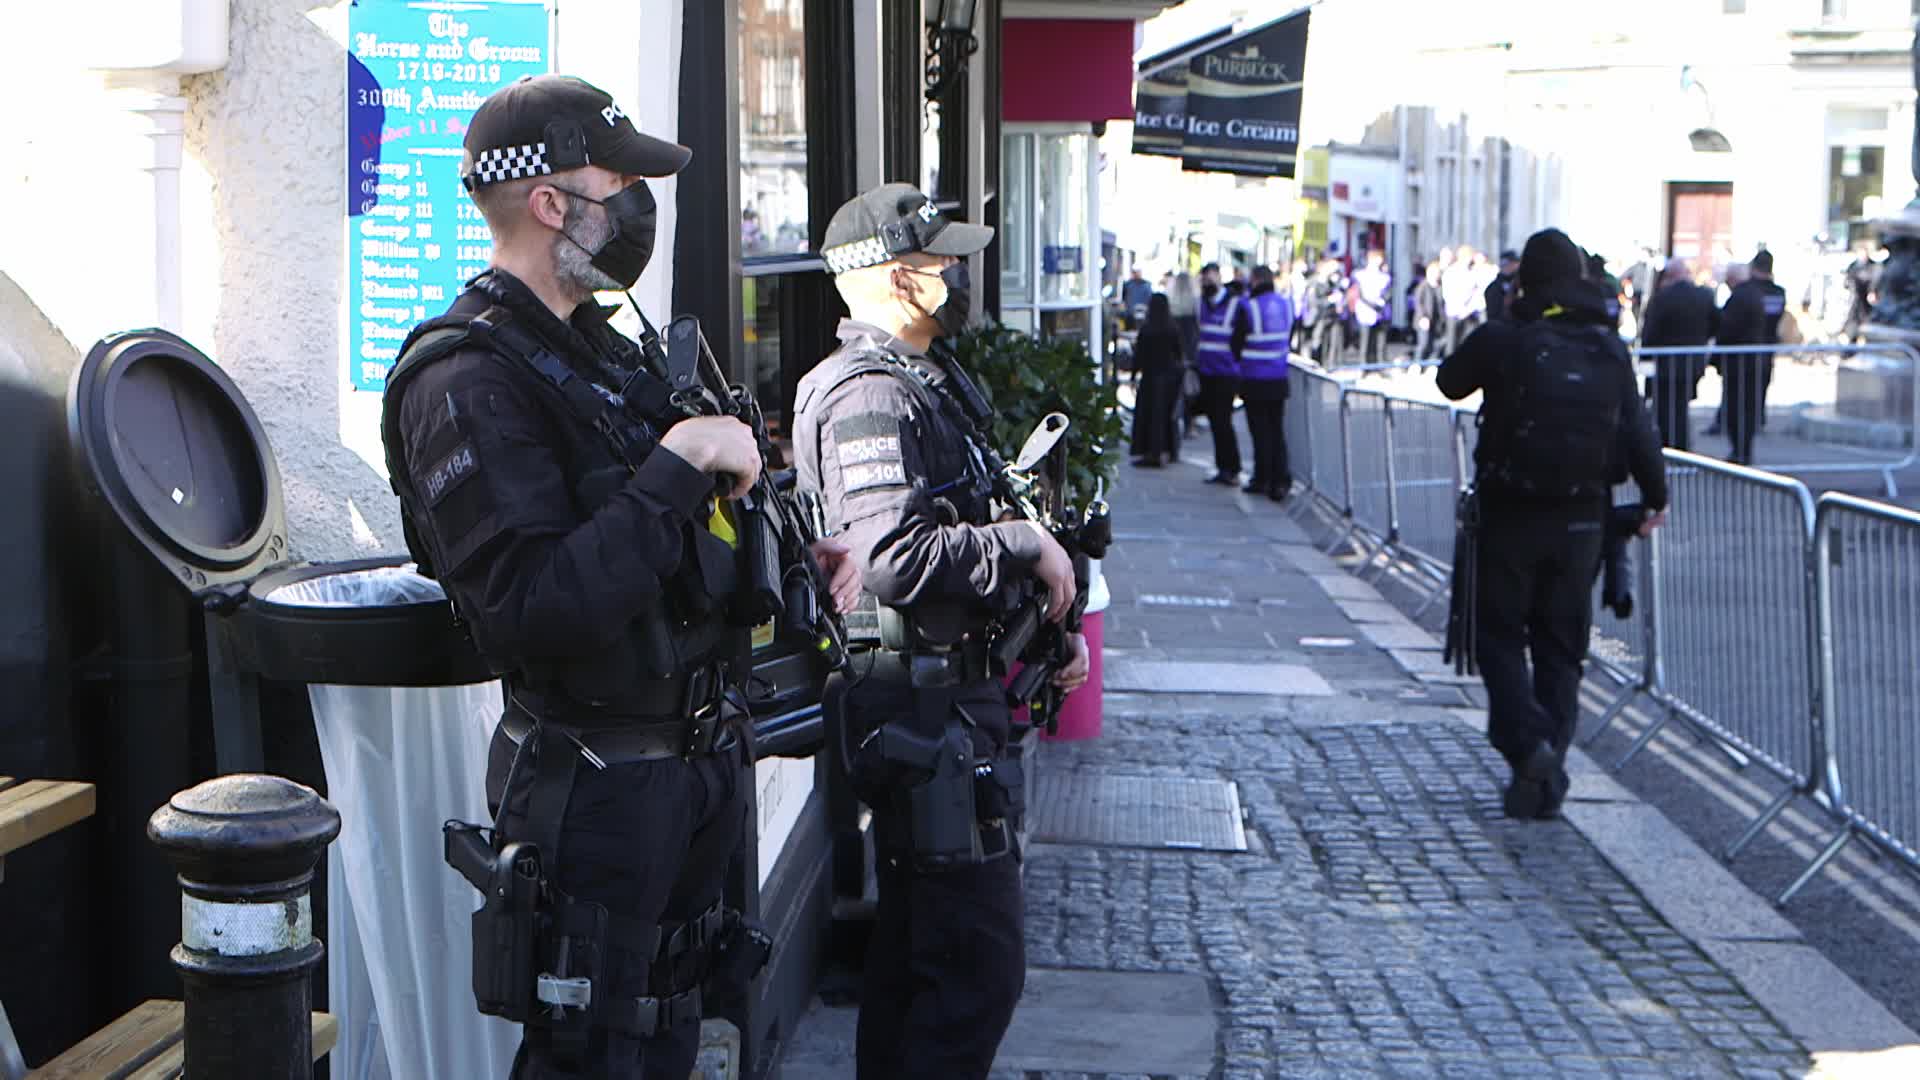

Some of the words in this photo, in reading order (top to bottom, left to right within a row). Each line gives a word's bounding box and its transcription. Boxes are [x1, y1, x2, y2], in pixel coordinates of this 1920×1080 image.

[428, 12, 469, 38] The
[355, 32, 421, 58] Horse
[425, 38, 464, 60] and
[468, 37, 542, 62] Groom
[396, 61, 502, 83] 1719-2019
[1204, 54, 1289, 83] PURBECK
[357, 87, 411, 114] 300th
[1188, 116, 1220, 136] Ice
[1225, 119, 1297, 144] Cream
[361, 159, 410, 180] George
[361, 179, 410, 201] George
[415, 181, 427, 197] II
[361, 199, 410, 222] George
[415, 202, 432, 219] III
[360, 219, 410, 243] George
[361, 239, 419, 260] William
[361, 260, 419, 281] Victoria
[361, 280, 418, 302] Edward
[360, 301, 410, 323] George
[837, 436, 898, 458] POLICE
[426, 449, 473, 498] HB-184
[847, 464, 902, 484] HB-101
